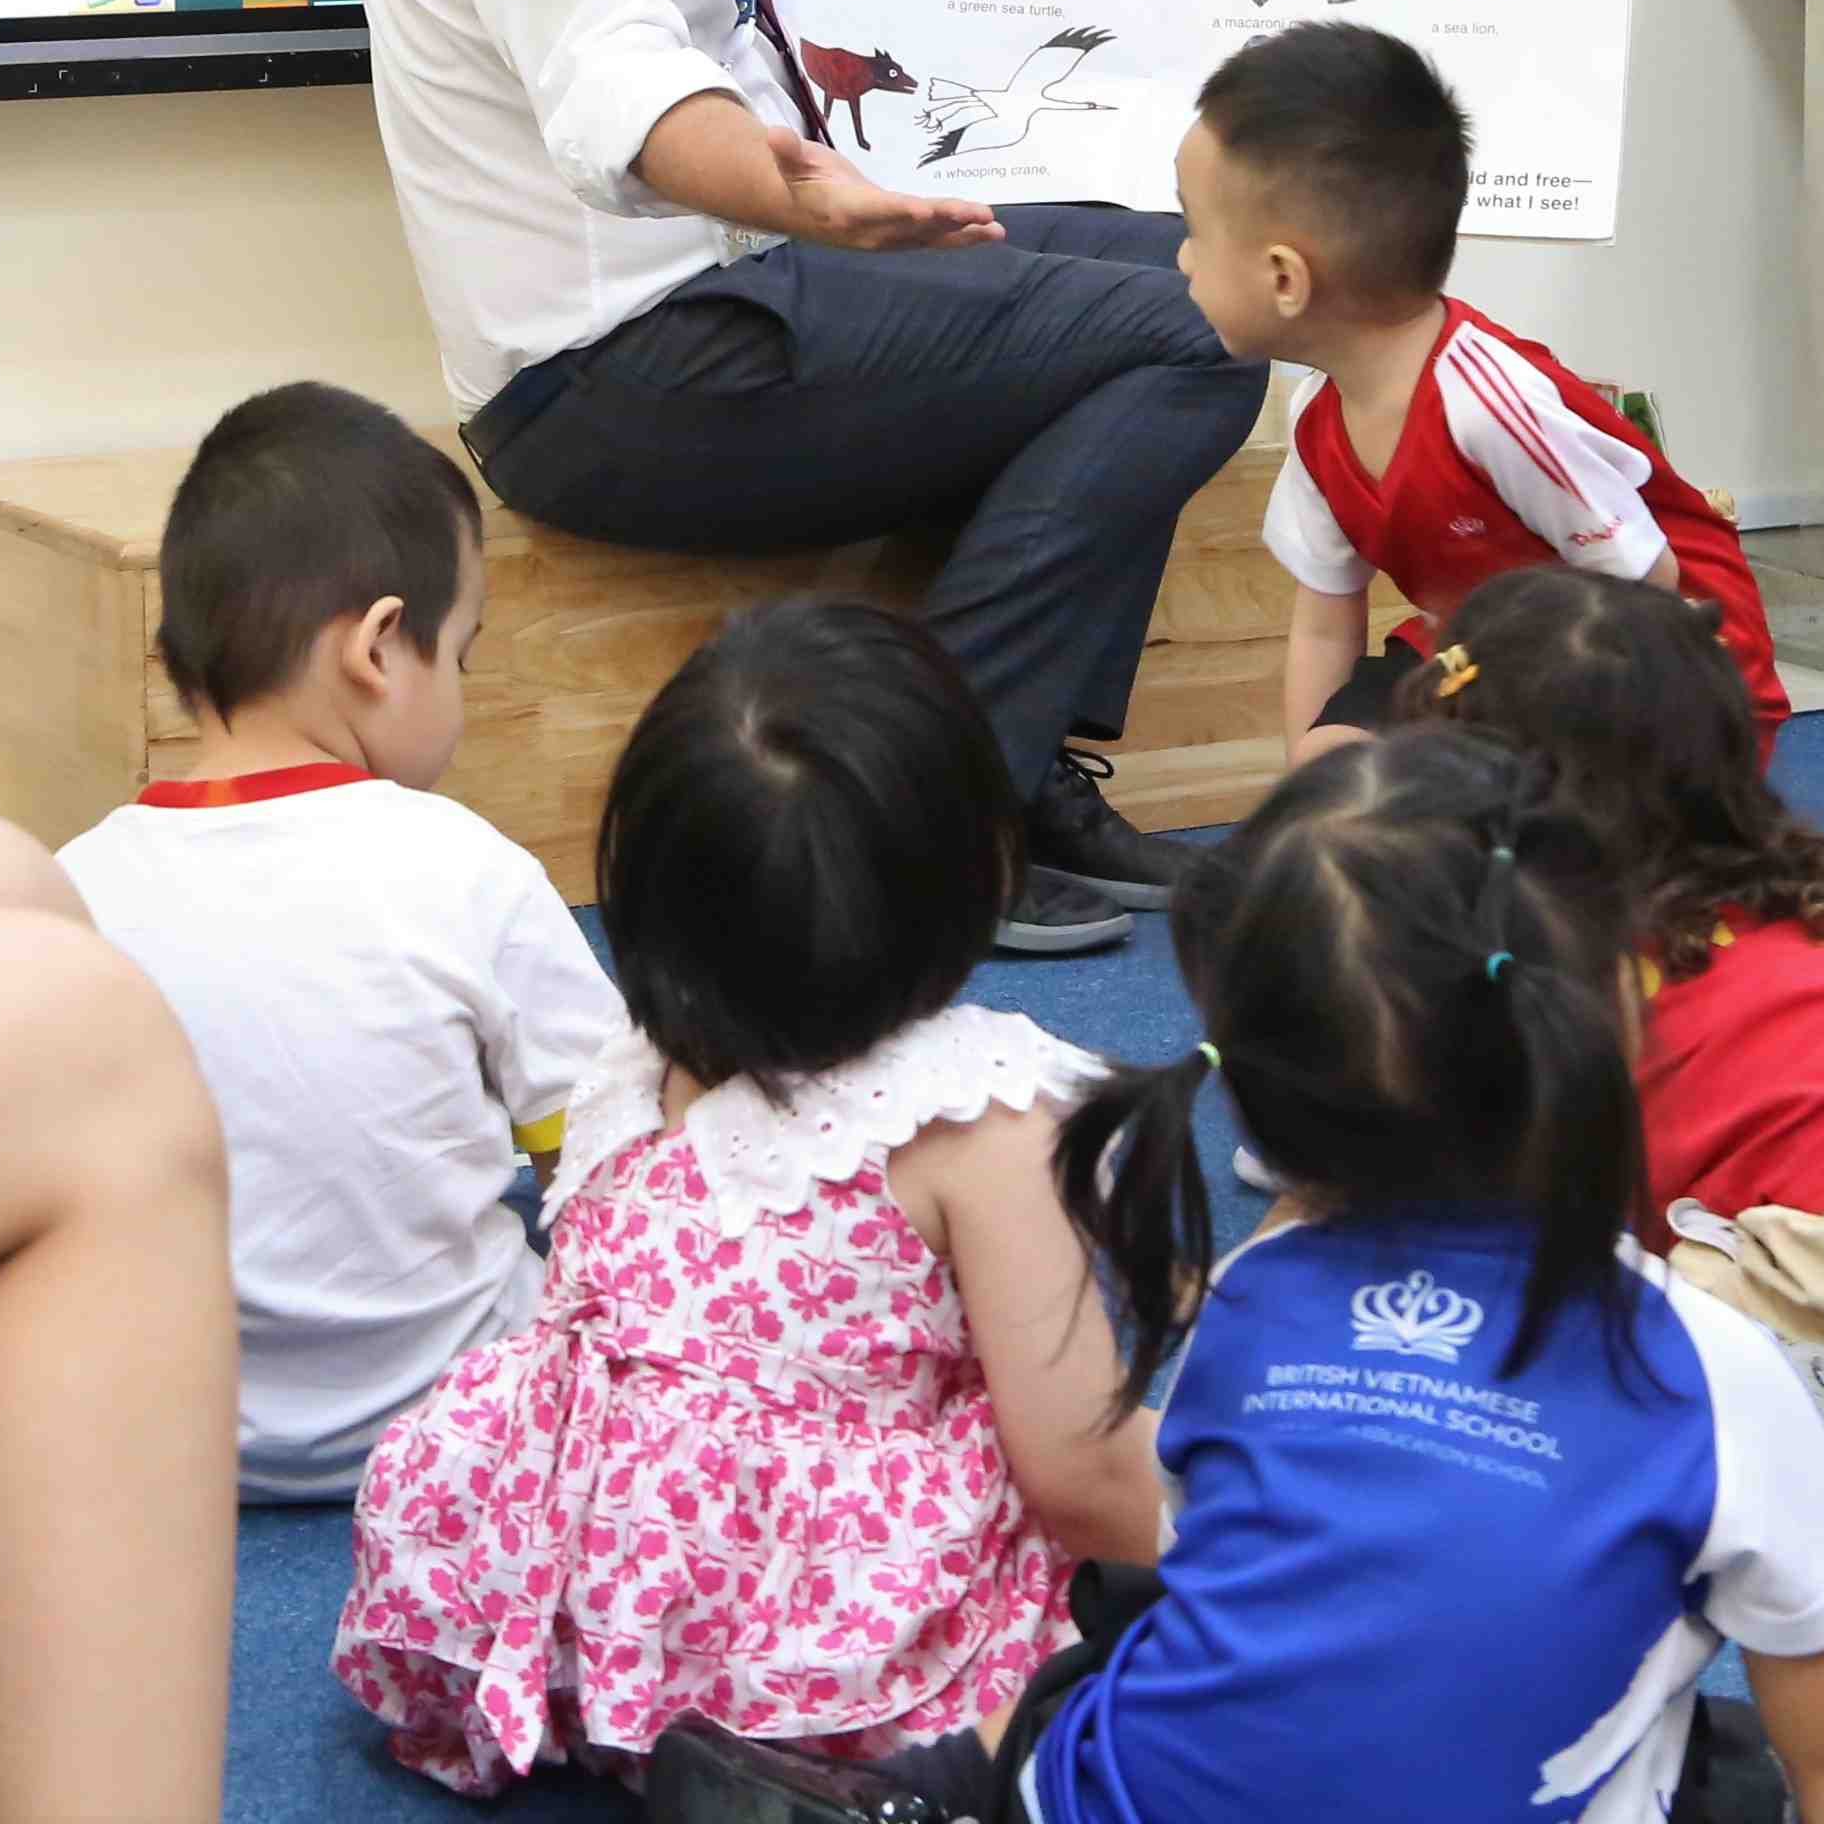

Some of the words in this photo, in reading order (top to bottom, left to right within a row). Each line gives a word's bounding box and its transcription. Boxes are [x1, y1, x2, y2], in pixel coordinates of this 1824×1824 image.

[959, 0, 998, 14] green
[1001, 4, 1025, 15] sea
[1444, 23, 1468, 33] sea
[1494, 172, 1529, 187] and
[1476, 193, 1522, 209] what
[1528, 195, 1534, 209] I
[1540, 195, 1579, 211] see!
[1266, 1364, 1361, 1388] BRITISH
[1363, 1367, 1540, 1425] VIETNAMESE
[1242, 1388, 1439, 1426] INTERNATIONAL
[1445, 1408, 1563, 1461] SCHOOL
